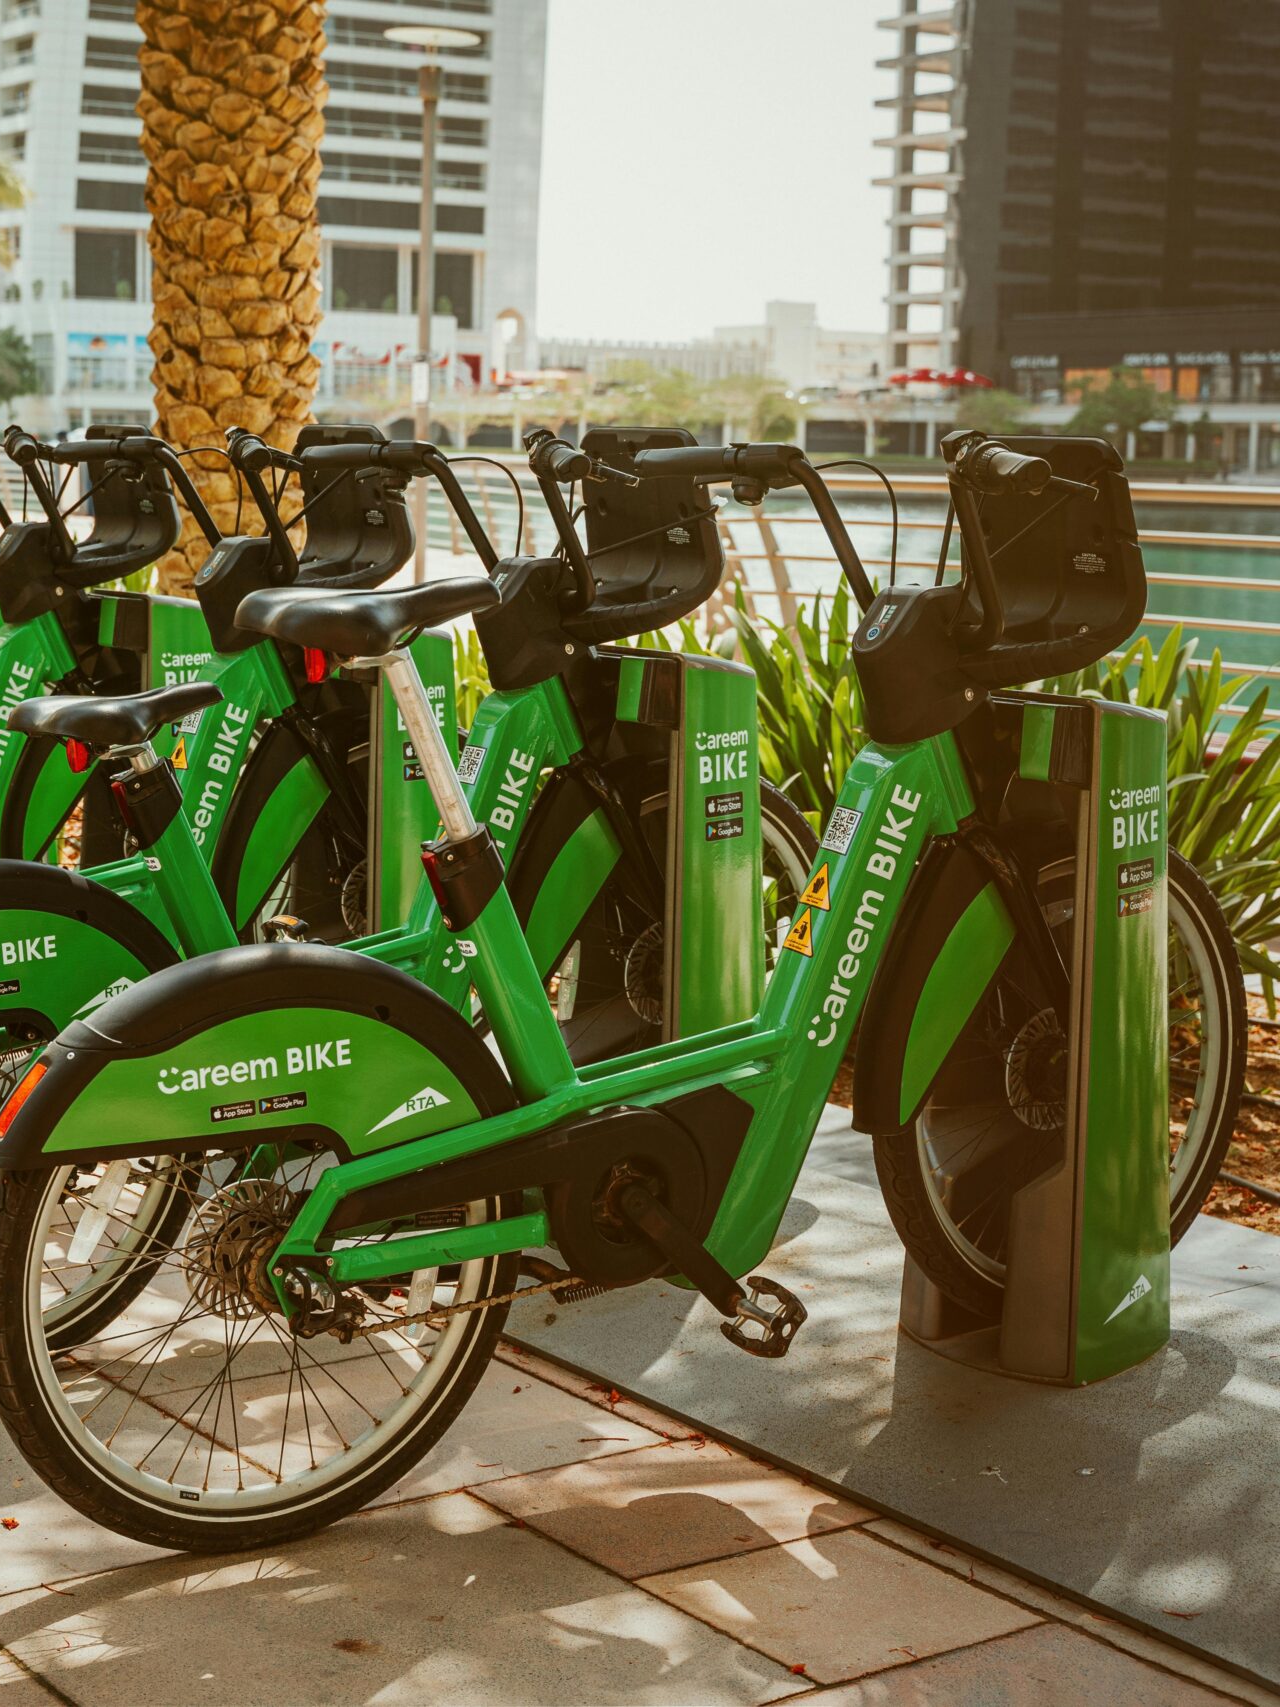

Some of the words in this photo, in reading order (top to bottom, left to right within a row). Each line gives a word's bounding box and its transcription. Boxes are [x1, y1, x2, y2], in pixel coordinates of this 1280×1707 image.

[695, 729, 749, 751] Careem
[190, 779, 224, 848] eem
[207, 702, 250, 775] BIKE
[699, 750, 748, 784] BIKE
[489, 748, 535, 831] BIKE
[1109, 784, 1160, 811] Careem
[1113, 809, 1159, 850] BIKE
[807, 888, 885, 1047] Careem
[865, 783, 922, 881] BIKE
[1, 935, 57, 965] BIKE
[157, 1056, 278, 1095] Careem
[286, 1038, 352, 1075] BIKE
[223, 1110, 236, 1118] App
[237, 1107, 253, 1115] Store
[273, 1100, 293, 1109] Google
[293, 1098, 305, 1106] Play
[405, 1095, 437, 1113] RTA
[1129, 1283, 1146, 1301] RTA
